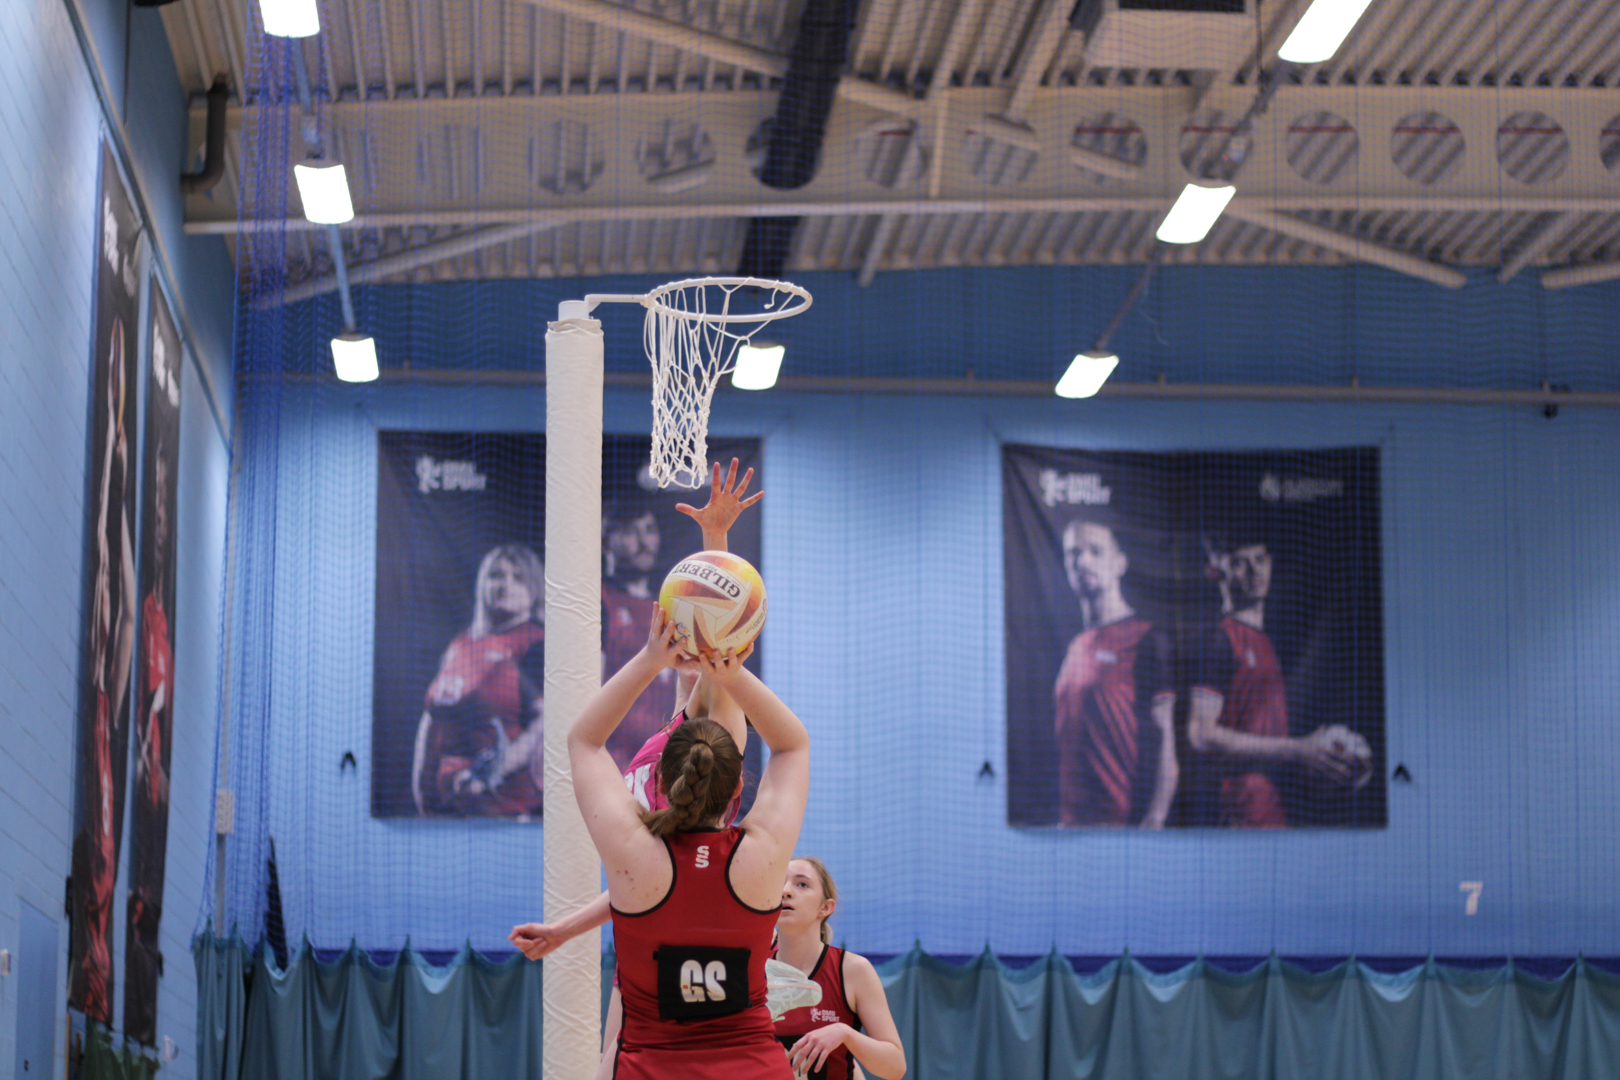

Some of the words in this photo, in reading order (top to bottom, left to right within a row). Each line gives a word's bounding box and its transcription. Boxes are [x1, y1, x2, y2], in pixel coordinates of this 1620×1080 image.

[672, 563, 741, 598] GILBERT
[1459, 881, 1484, 916] 7
[680, 959, 727, 1003] GS
